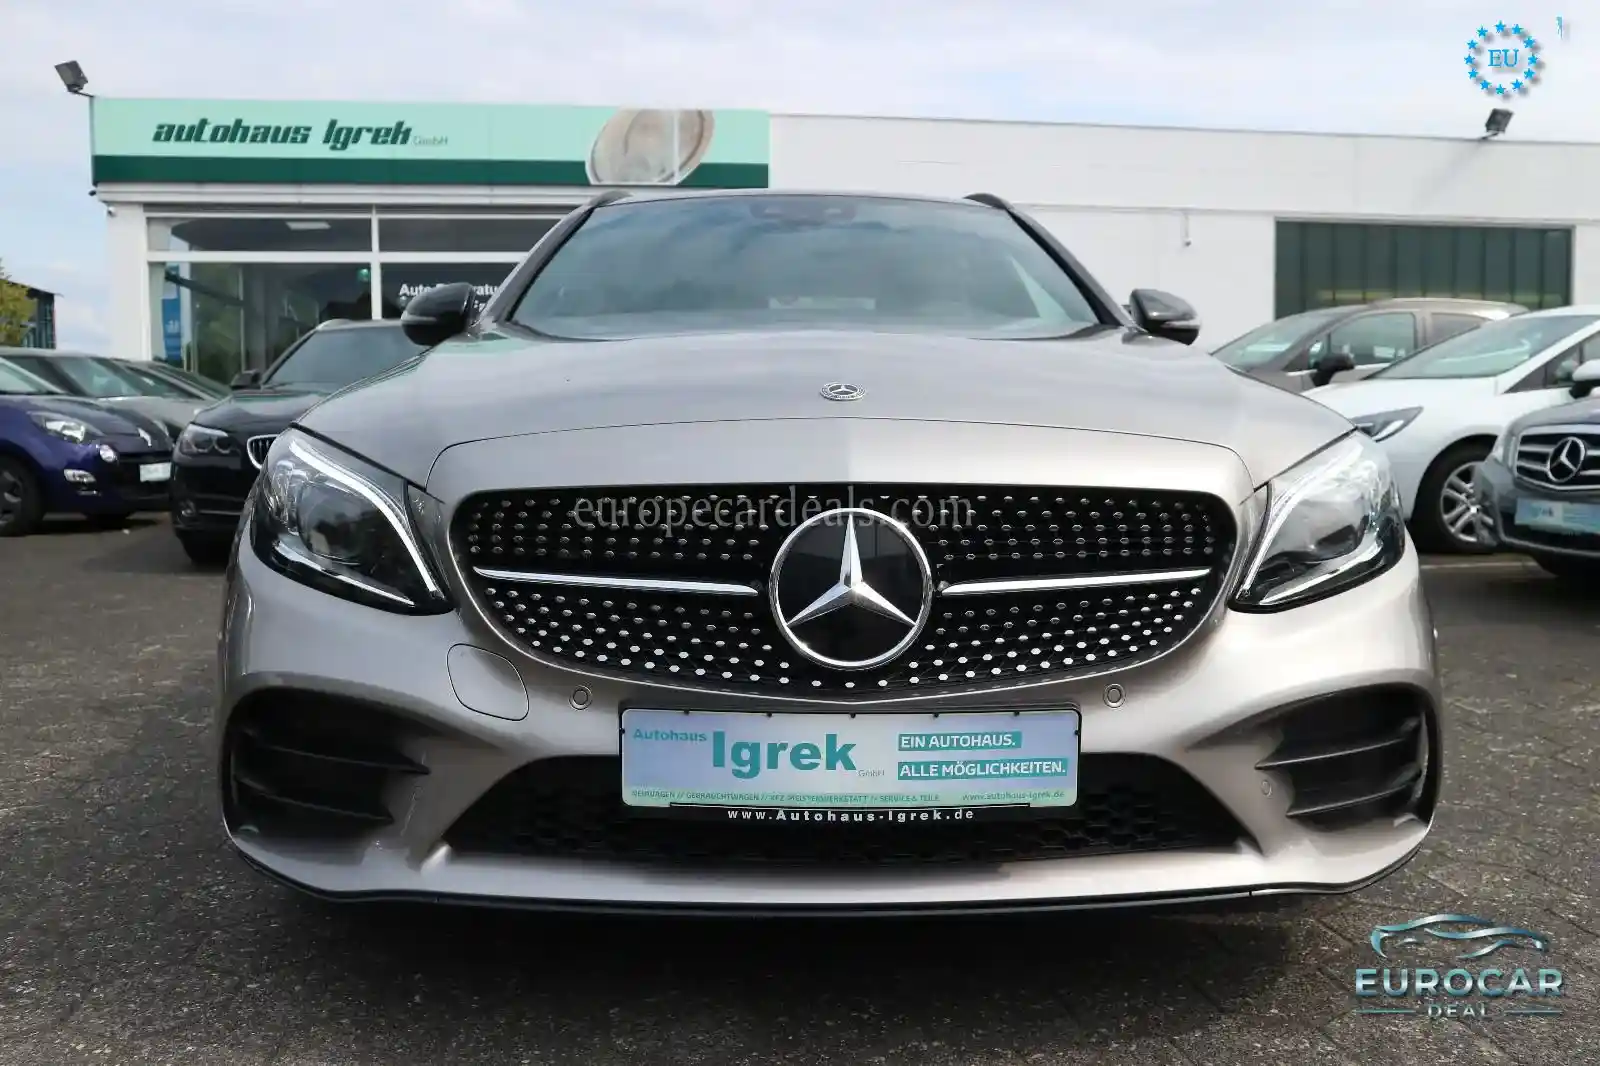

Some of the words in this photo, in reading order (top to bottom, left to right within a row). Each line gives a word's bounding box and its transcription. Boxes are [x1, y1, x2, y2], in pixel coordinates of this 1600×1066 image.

[152, 118, 312, 143] autohaus
[322, 119, 412, 150] Igrek
[413, 135, 448, 147] GmbH
[633, 729, 707, 742] Autohaus
[900, 736, 925, 748] EIN
[929, 734, 1016, 748] AUTOHAUS.
[713, 731, 857, 779] Igrek
[900, 764, 938, 777] ALLE
[942, 761, 1066, 776] MÖGLICHKEITEN.
